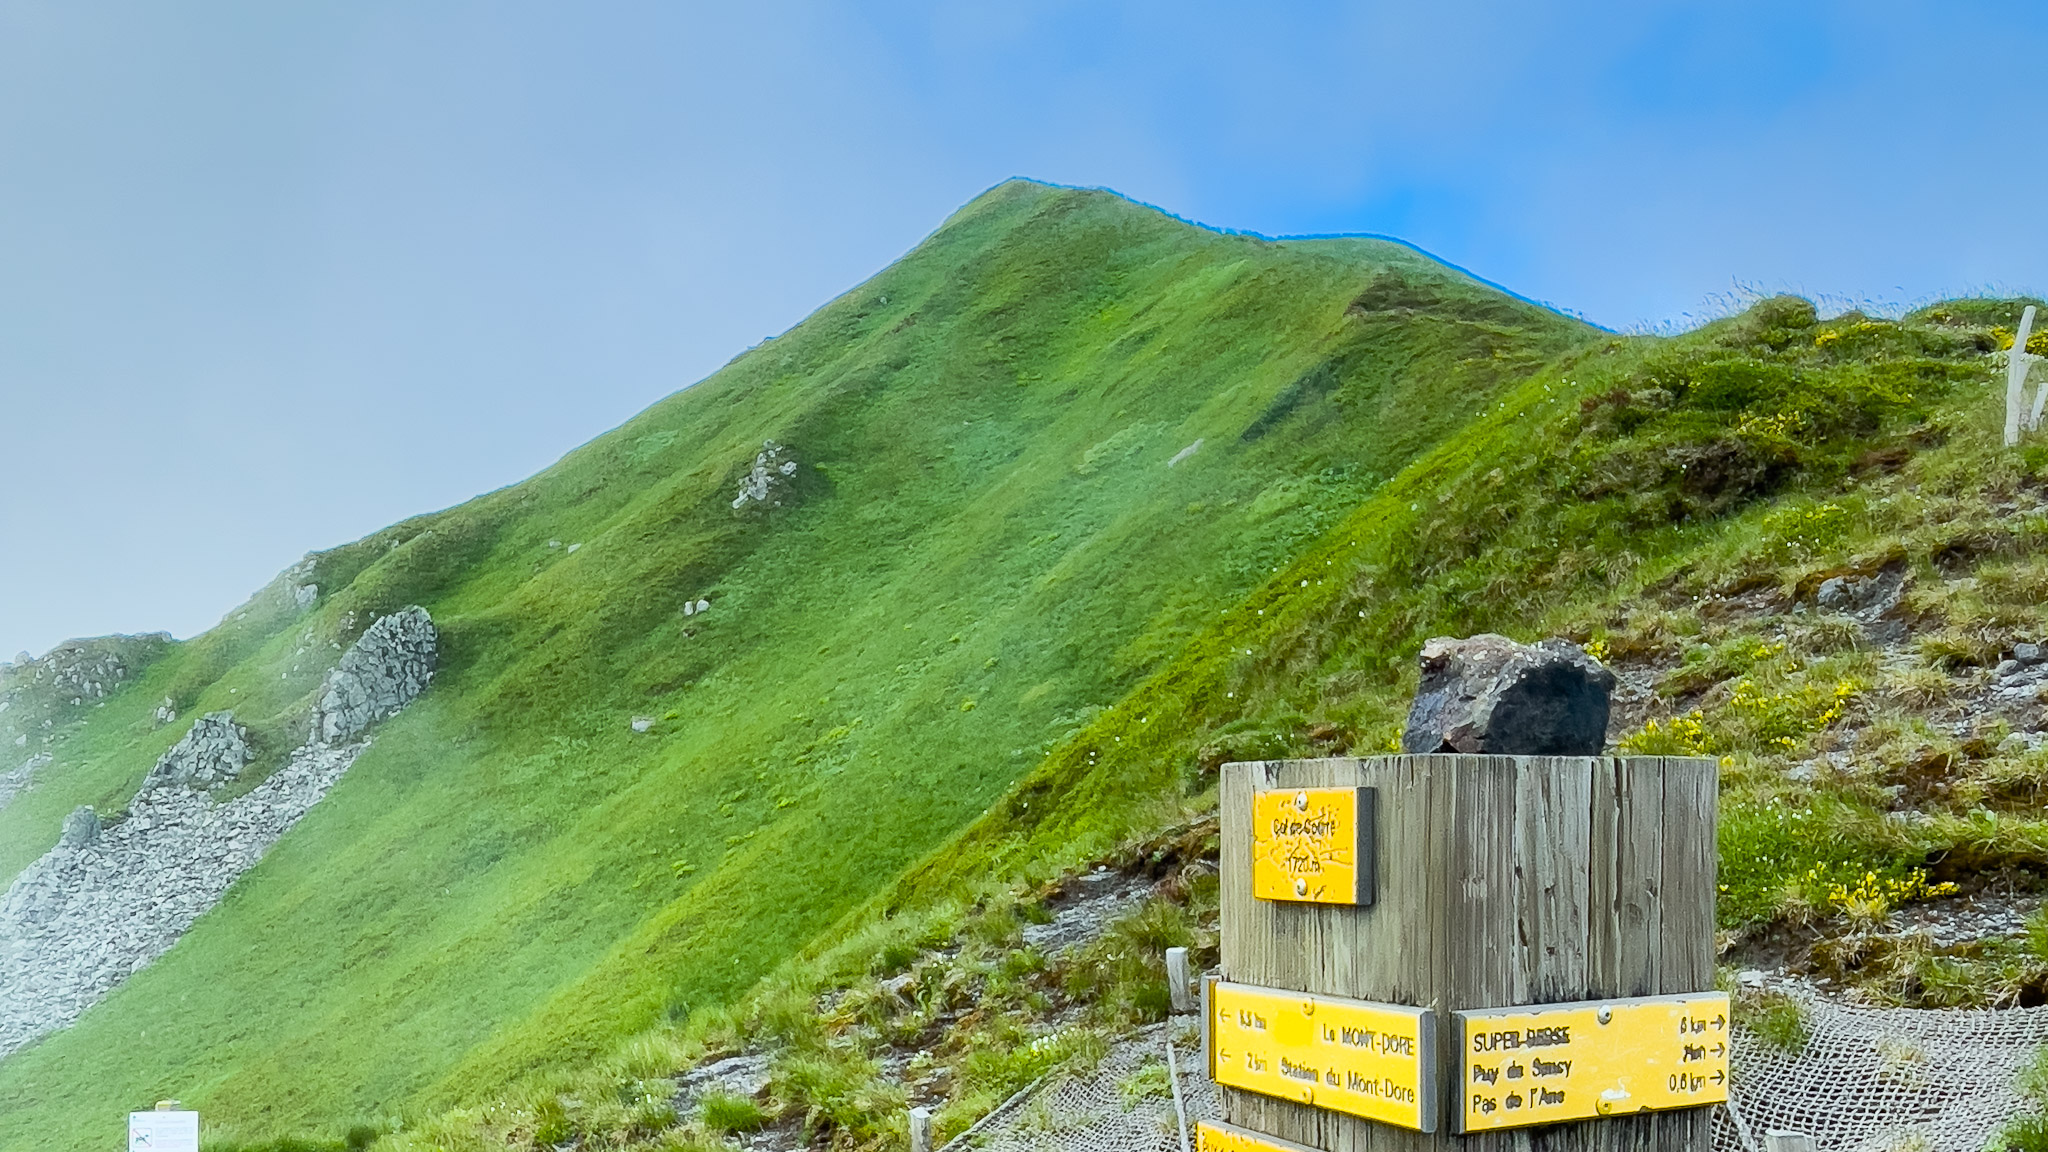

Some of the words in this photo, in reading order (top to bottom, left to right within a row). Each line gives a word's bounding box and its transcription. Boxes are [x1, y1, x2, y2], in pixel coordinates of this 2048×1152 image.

[1691, 1016, 1707, 1035] km
[1323, 1023, 1335, 1042] Le
[1342, 1026, 1415, 1056] MONT-DORE
[1280, 1056, 1319, 1083] Station
[1326, 1067, 1341, 1087] du
[1347, 1070, 1415, 1104] Mont-Dore
[1473, 1064, 1499, 1086] Puy
[1532, 1057, 1572, 1078] Sancy
[1690, 1072, 1706, 1092] km
[1473, 1094, 1497, 1113] Pas
[1505, 1091, 1523, 1110] de
